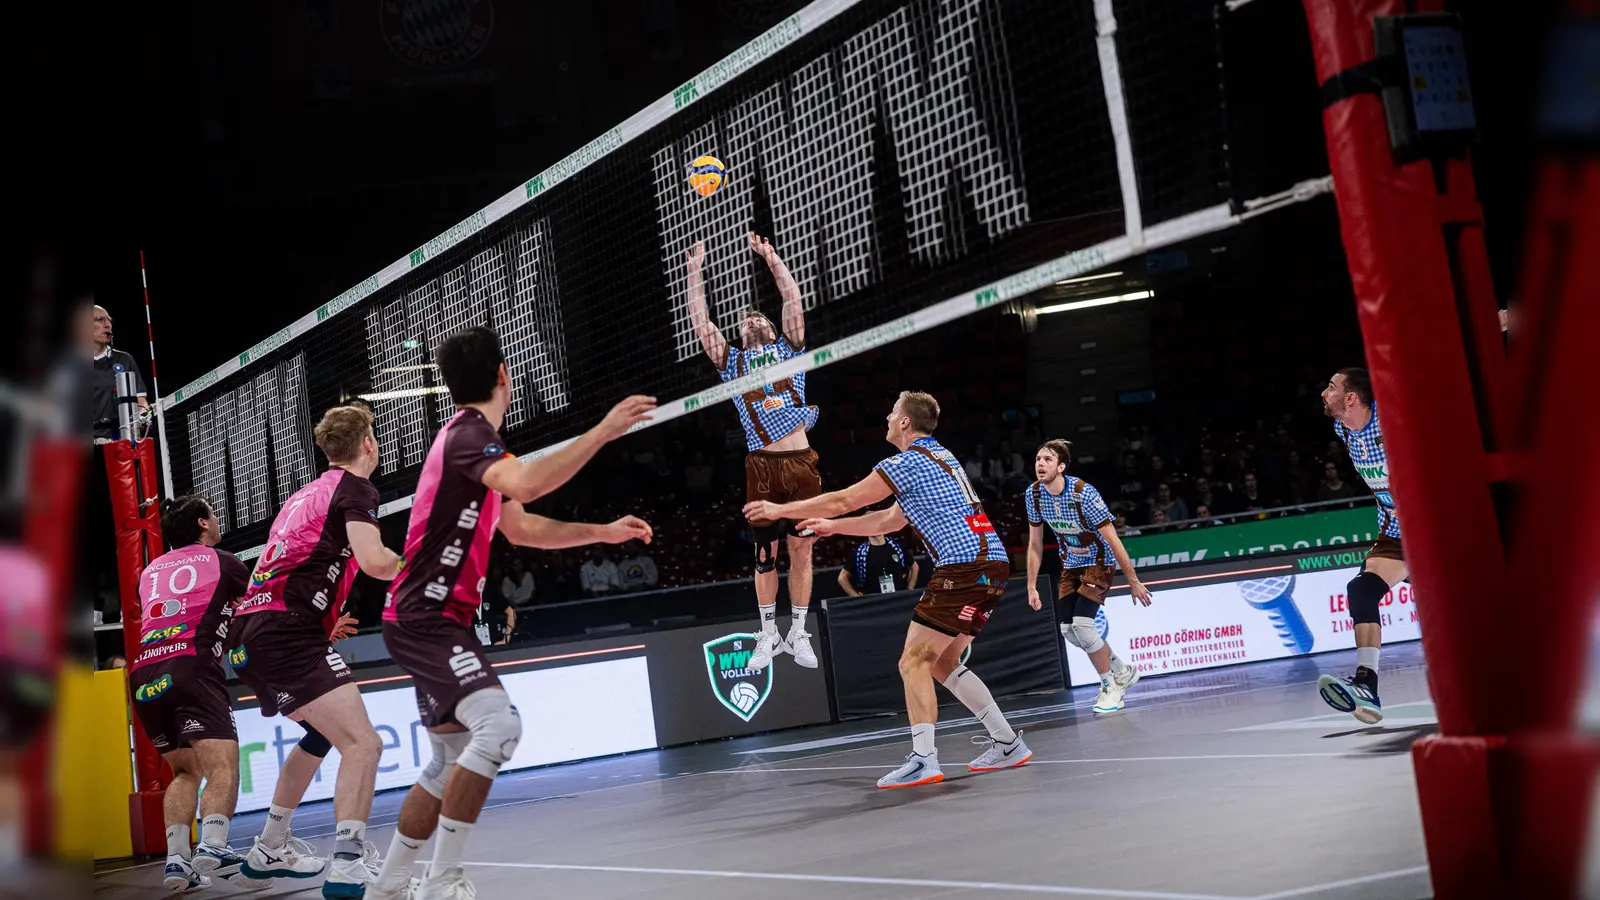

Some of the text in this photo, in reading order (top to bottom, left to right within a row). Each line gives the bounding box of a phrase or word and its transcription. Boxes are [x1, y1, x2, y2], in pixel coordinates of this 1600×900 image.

[673, 14, 802, 109] WWK VERSICHERUNGEN
[525, 126, 623, 199] WWK VERSICHERUNGEN
[410, 210, 487, 268] WWK VERSICHERUNGEN
[975, 286, 998, 306] WWK
[814, 350, 833, 366] WWK
[1297, 555, 1333, 571] WWK
[149, 565, 197, 602] 10
[1130, 624, 1243, 650] LEOPOLD GÖRING GMBH
[1131, 649, 1171, 662] ZIMMEREI
[1181, 640, 1245, 655] MEISTERBETRIEB
[1162, 662, 1168, 670] &
[1172, 650, 1247, 669] TIEFBAUTECHNIKER
[146, 678, 168, 697] RVS
